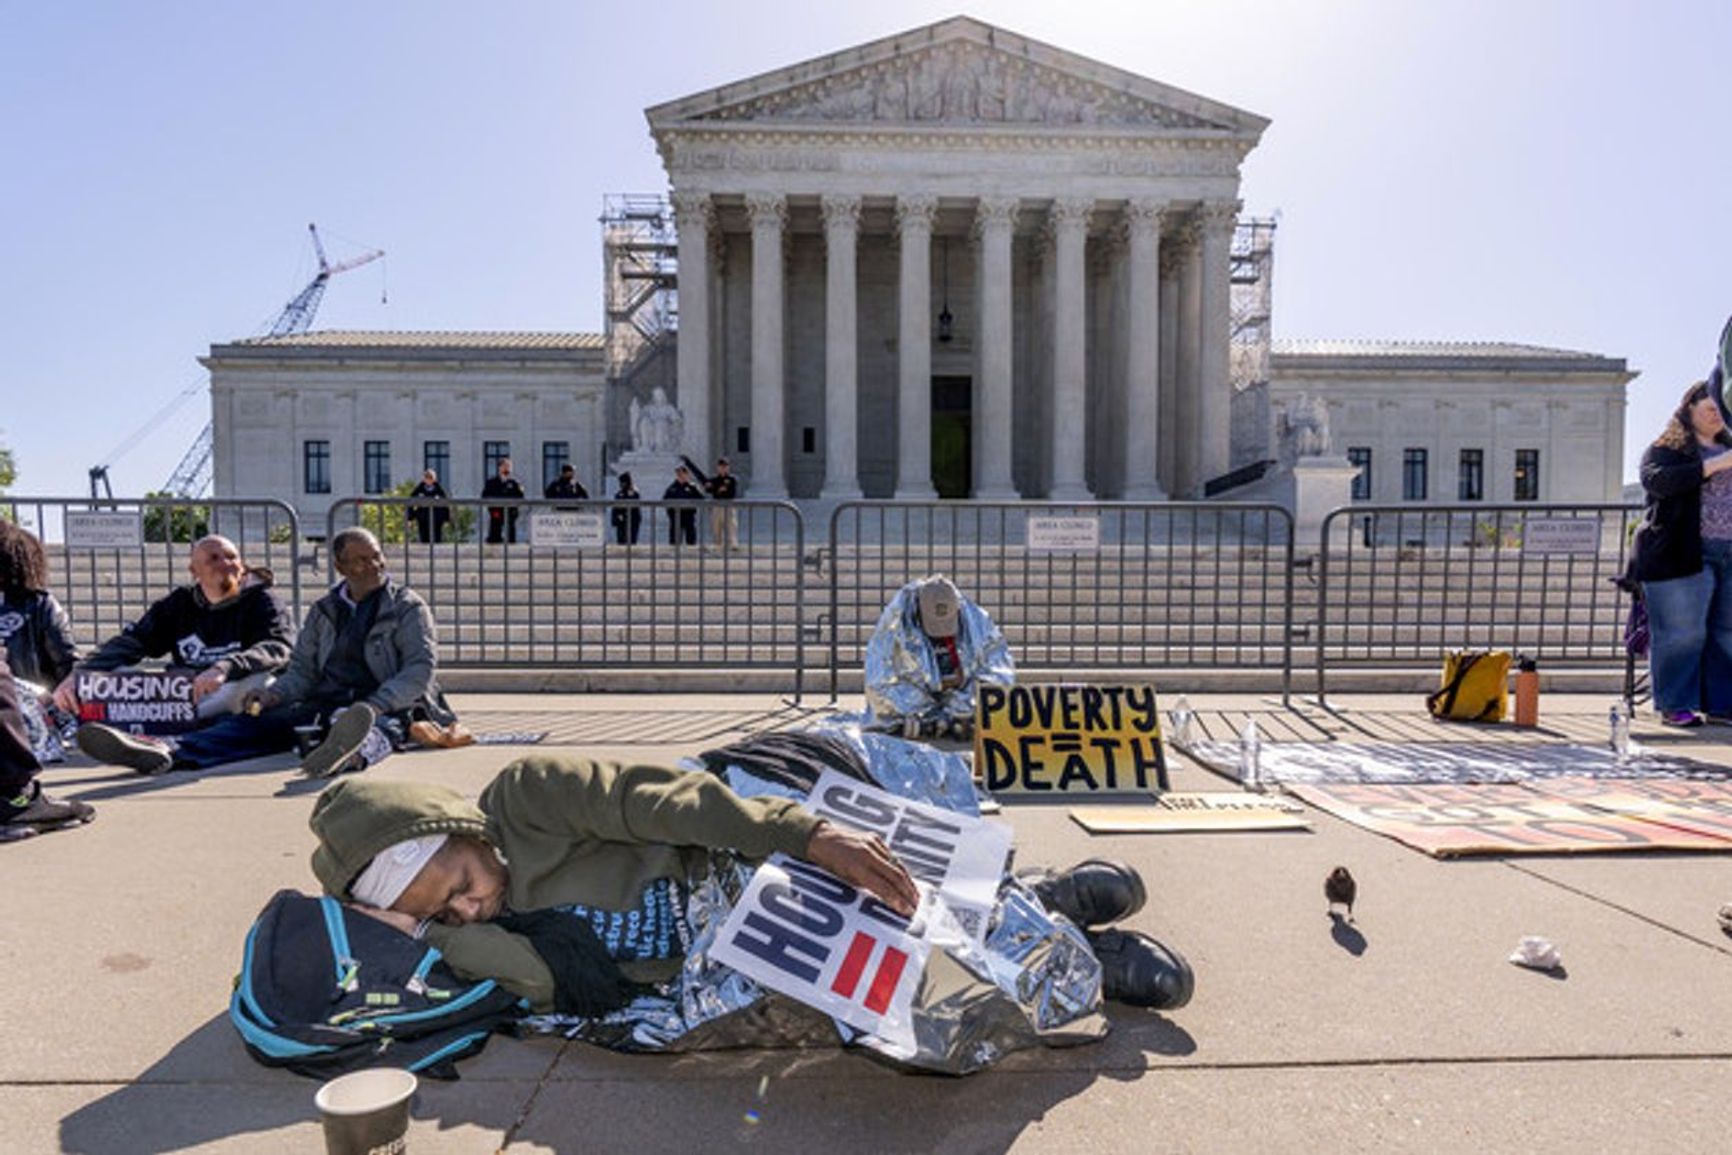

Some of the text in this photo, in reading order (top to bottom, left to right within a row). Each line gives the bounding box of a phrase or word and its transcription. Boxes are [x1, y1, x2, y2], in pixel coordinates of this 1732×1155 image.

[78, 676, 193, 700] HOUSING
[107, 701, 195, 721] HANDCUFFS
[979, 685, 1158, 733] POVERTY
[981, 735, 1171, 791] DEATH
